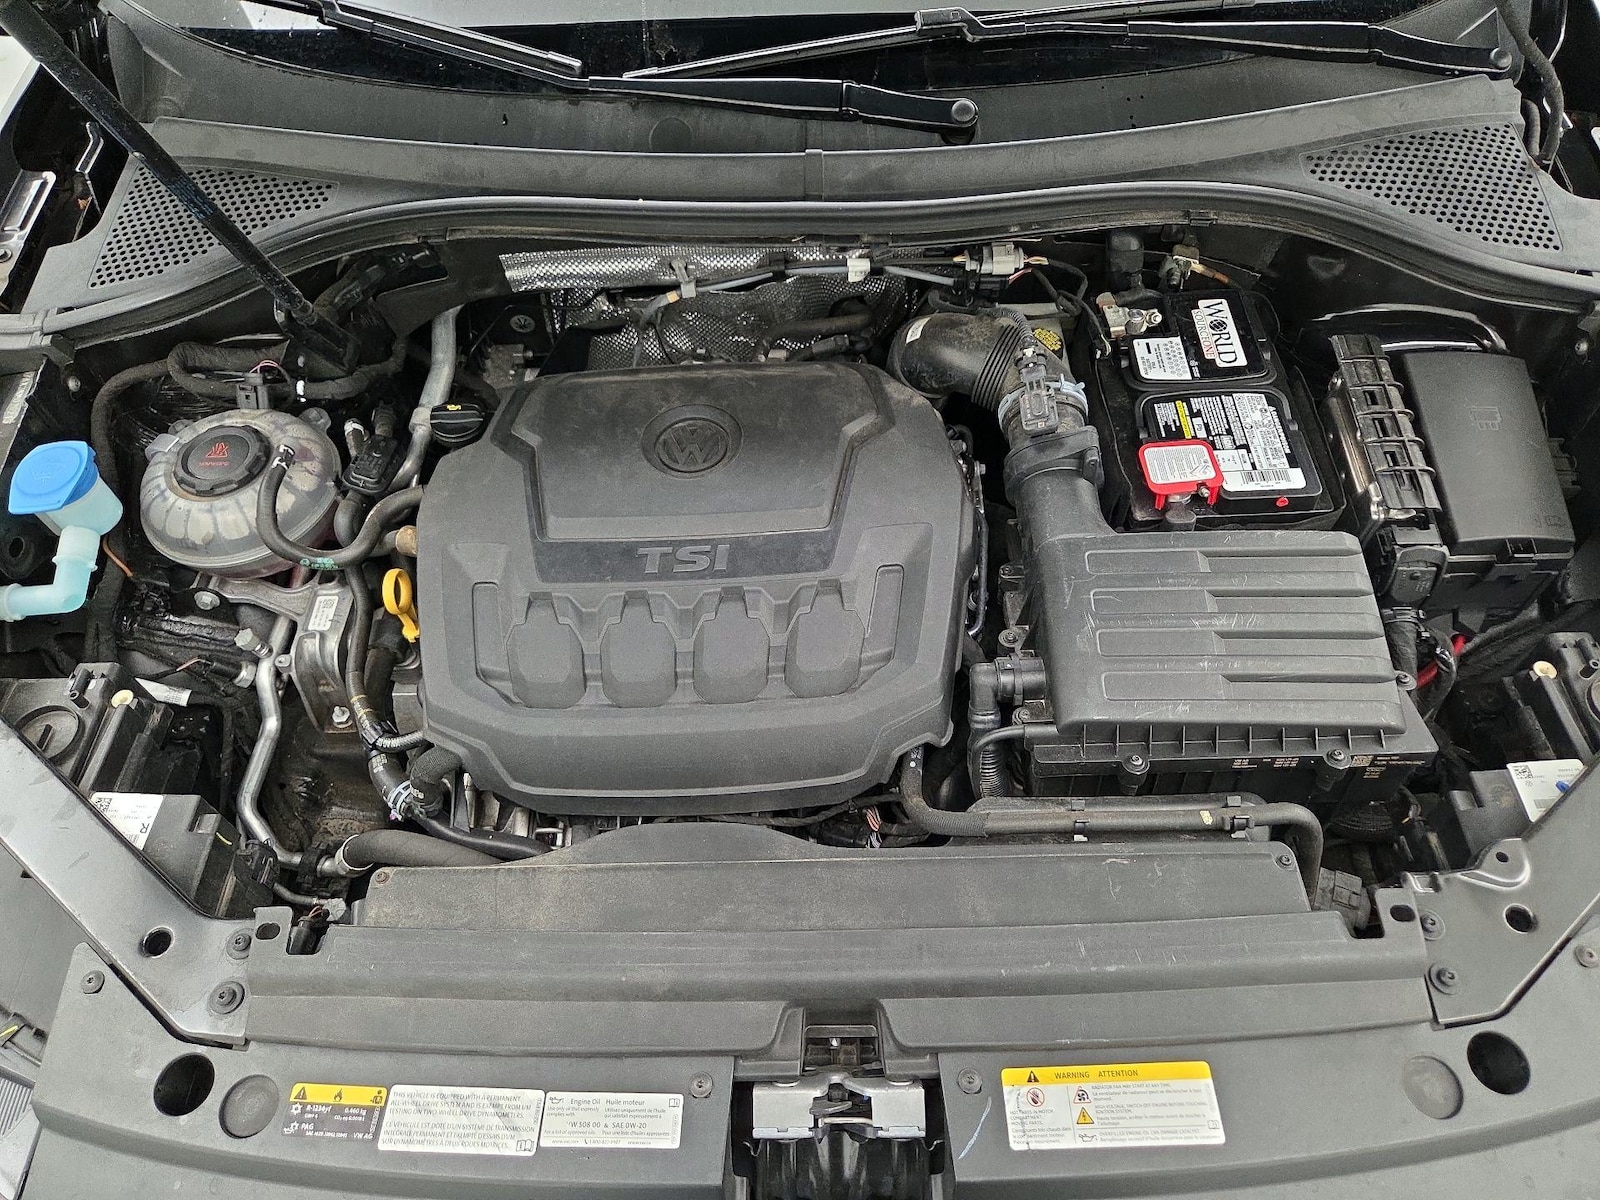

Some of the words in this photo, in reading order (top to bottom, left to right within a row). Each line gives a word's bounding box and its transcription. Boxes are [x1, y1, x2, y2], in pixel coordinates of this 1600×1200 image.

[1203, 301, 1238, 364] WORLD
[635, 544, 730, 574] TSI
[139, 823, 150, 834] R
[1054, 1071, 1090, 1079] WARNING
[1098, 1069, 1139, 1078] ATTENTION
[486, 1094, 521, 1102] PERMANENT
[570, 1098, 591, 1106] Engine
[305, 1104, 332, 1114] R-1234yf
[360, 1108, 367, 1116] kg
[301, 1122, 314, 1130] PAG
